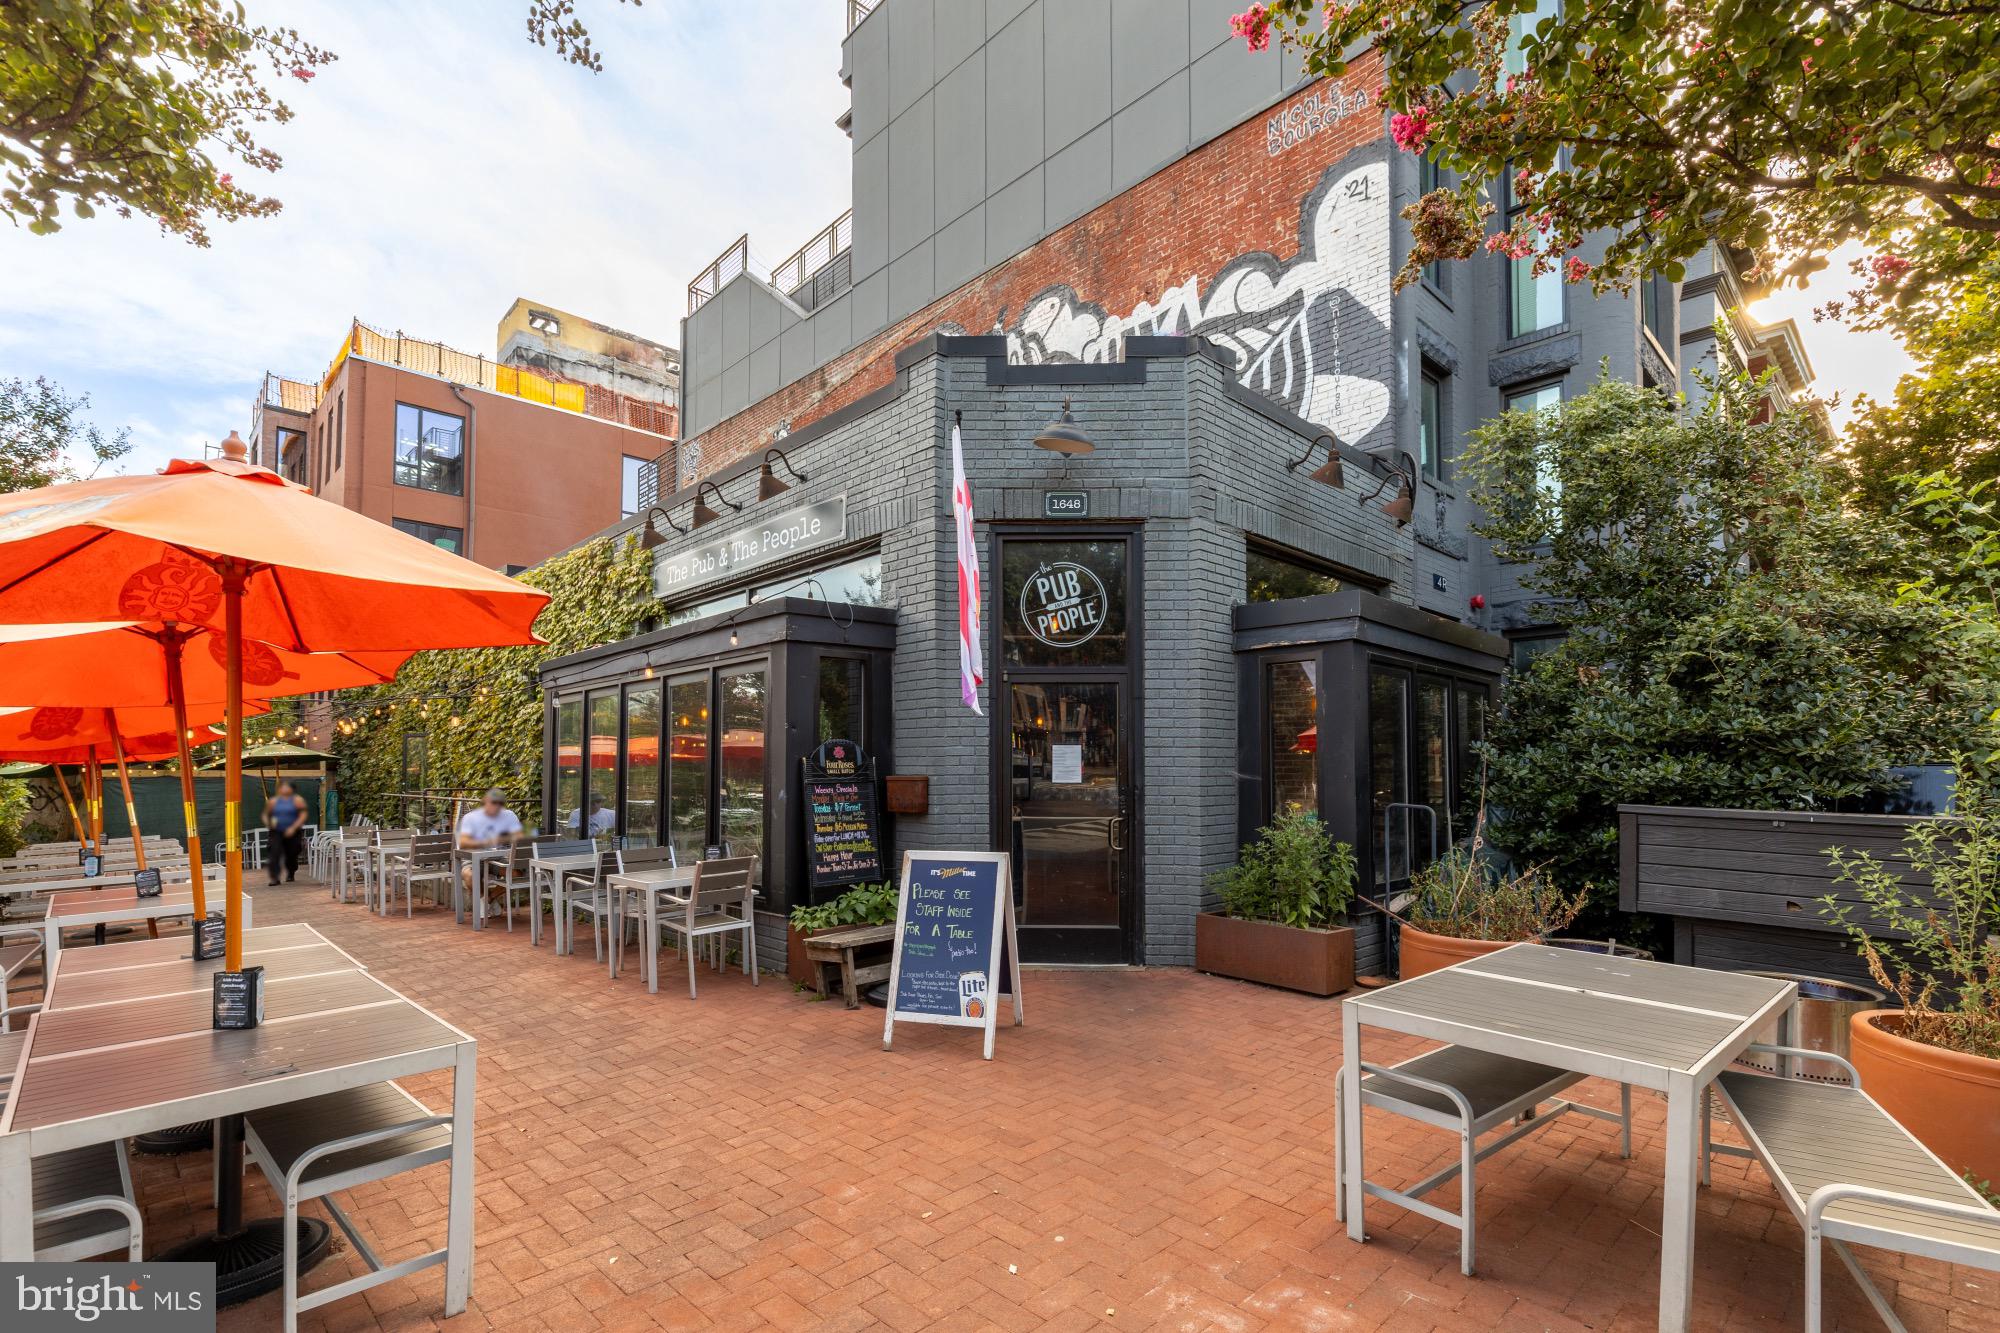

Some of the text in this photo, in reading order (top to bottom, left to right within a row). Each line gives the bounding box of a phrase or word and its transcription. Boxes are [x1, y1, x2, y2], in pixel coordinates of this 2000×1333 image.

[1267, 80, 1344, 139] NICOLE
[1268, 89, 1368, 157] BOURGEA
[1052, 499, 1081, 509] 1648
[667, 517, 821, 585] The Pub & The People
[1039, 561, 1053, 574] the
[1036, 570, 1081, 605] PUB
[1037, 603, 1099, 637] PEOPLE
[940, 867, 966, 880] Miller
[912, 882, 972, 900] PLEASE SEE
[915, 902, 973, 918] STAFF INSIDE
[904, 921, 974, 939] FOR A TABLE
[961, 980, 985, 997] Lite
